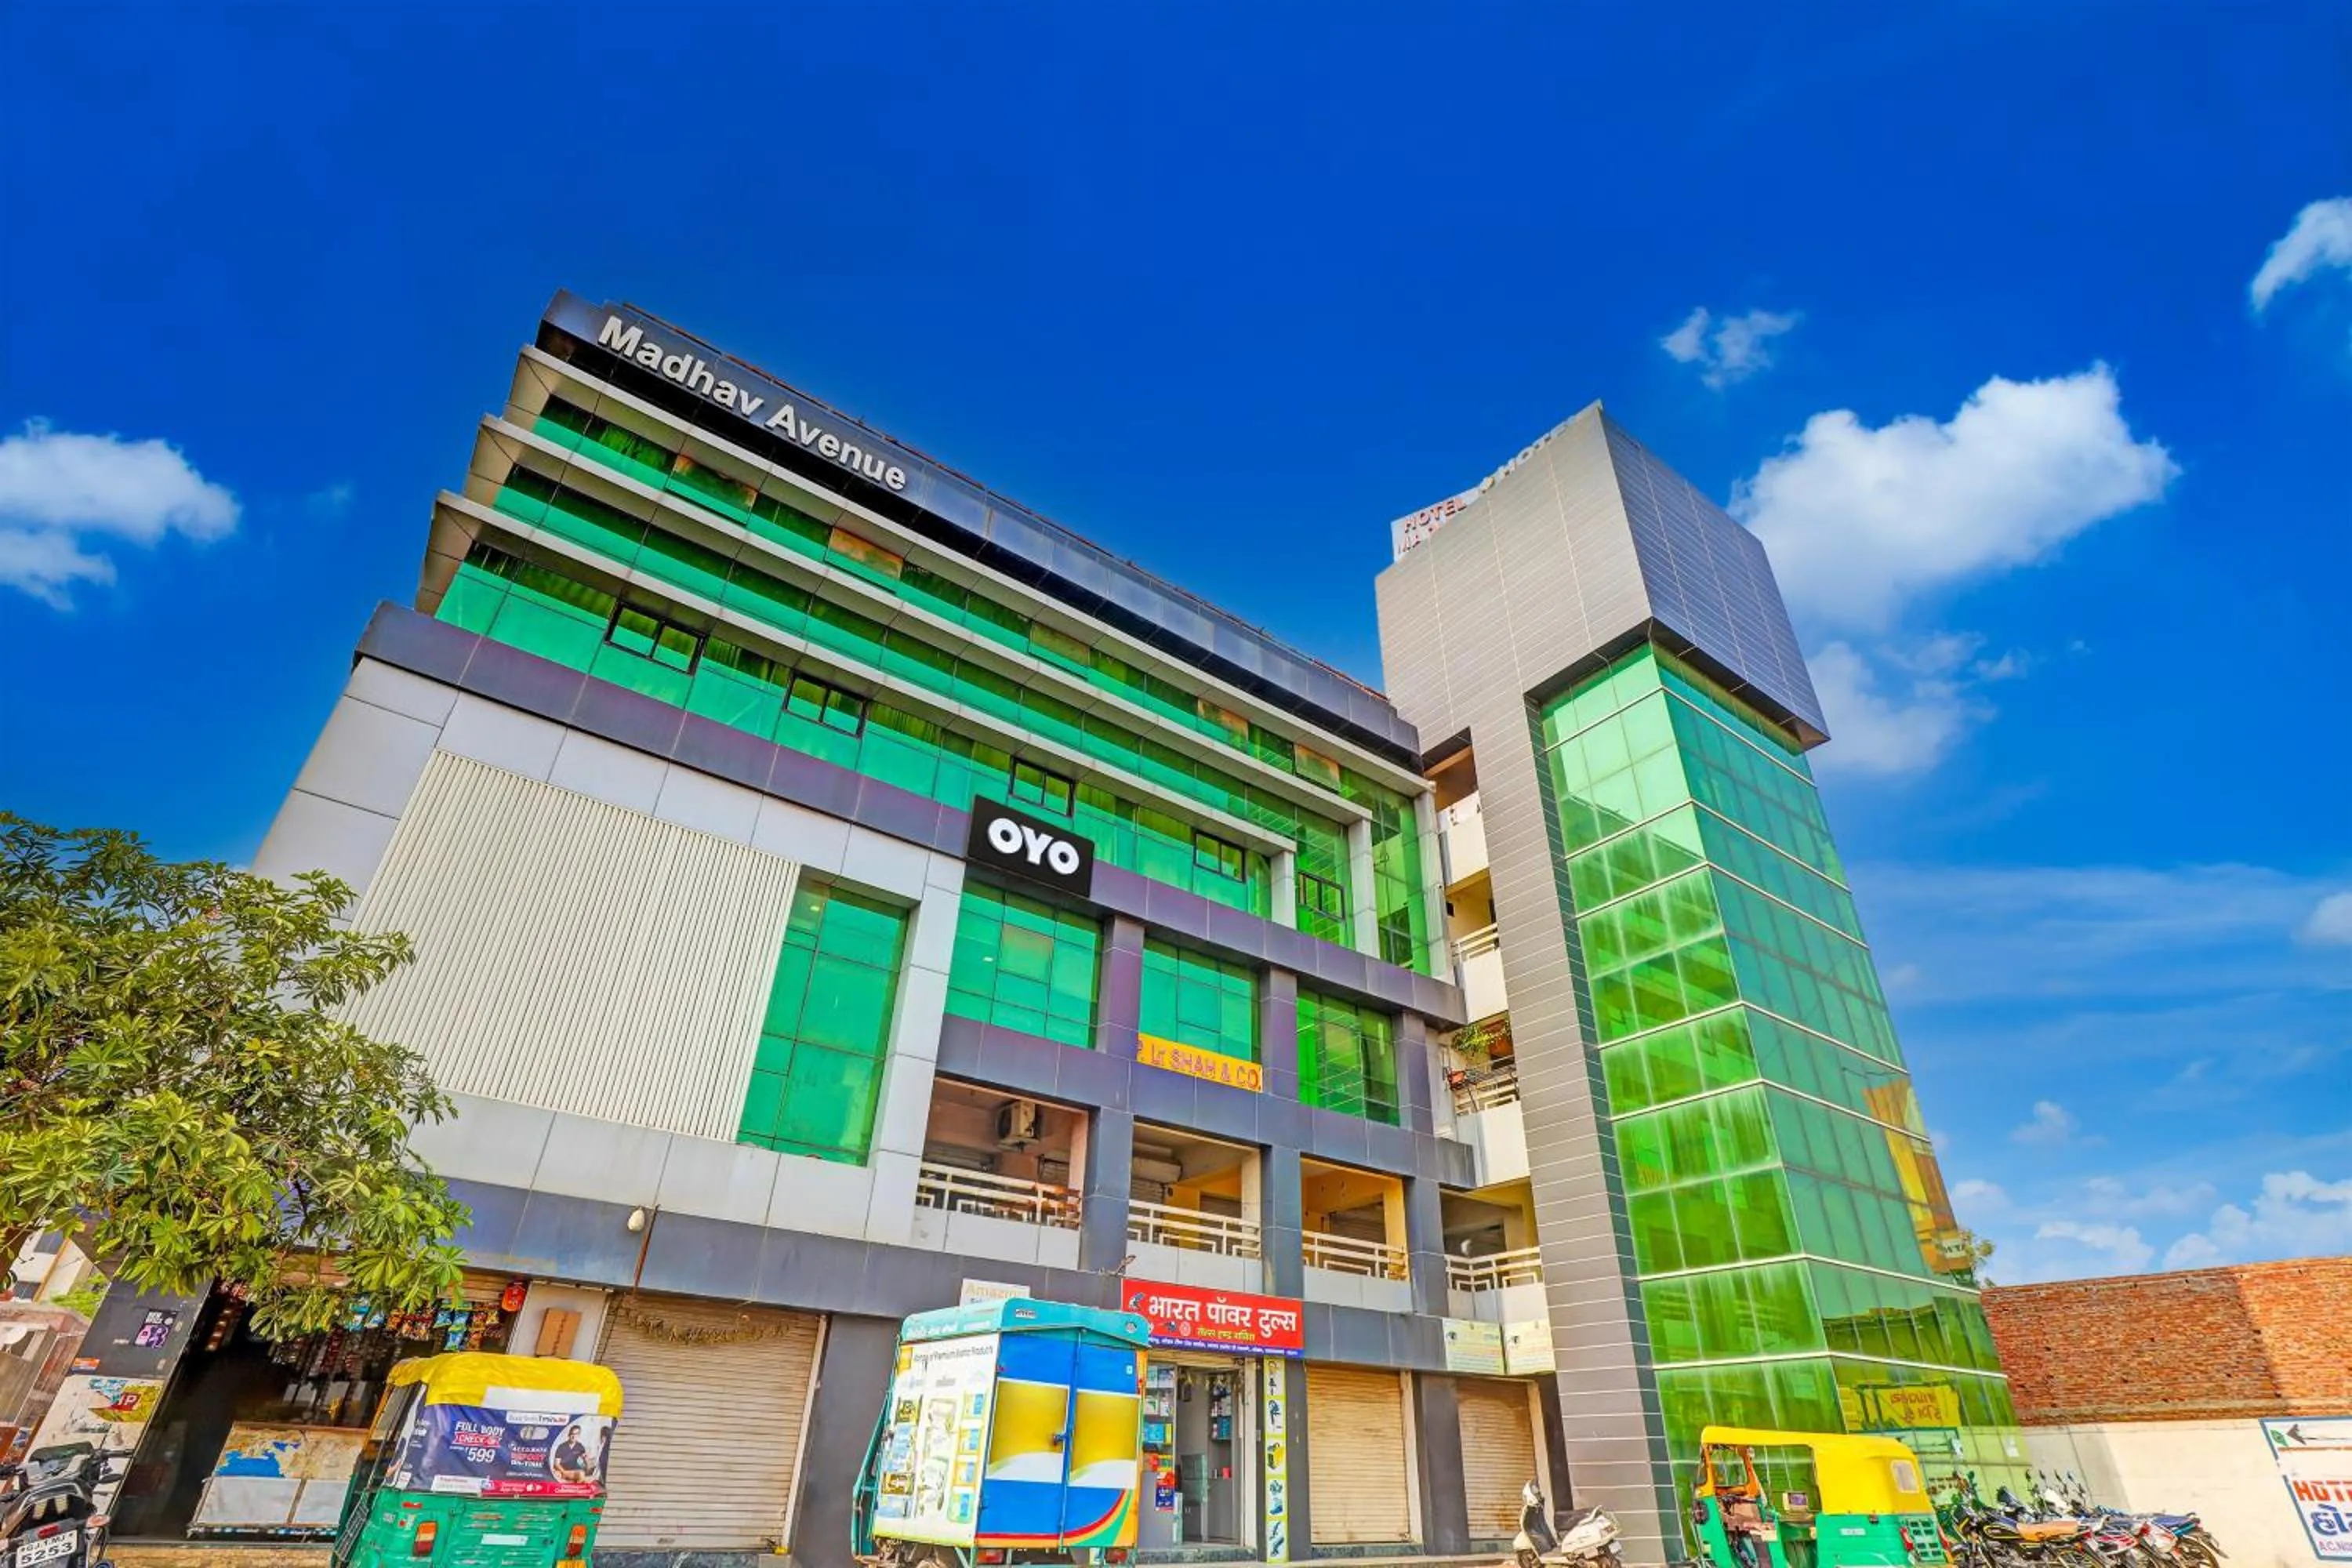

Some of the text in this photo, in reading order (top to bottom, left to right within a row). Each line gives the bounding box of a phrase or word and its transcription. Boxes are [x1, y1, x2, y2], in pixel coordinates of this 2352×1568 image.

[597, 315, 906, 492] Madhav Avenue
[1403, 498, 1468, 533] HOTEL
[988, 818, 1080, 875] OYO
[1149, 1296, 1201, 1322] भारत
[1206, 1298, 1252, 1327] पॉवर
[456, 1421, 506, 1437] FULL BODY
[21, 1543, 72, 1564] 5253
